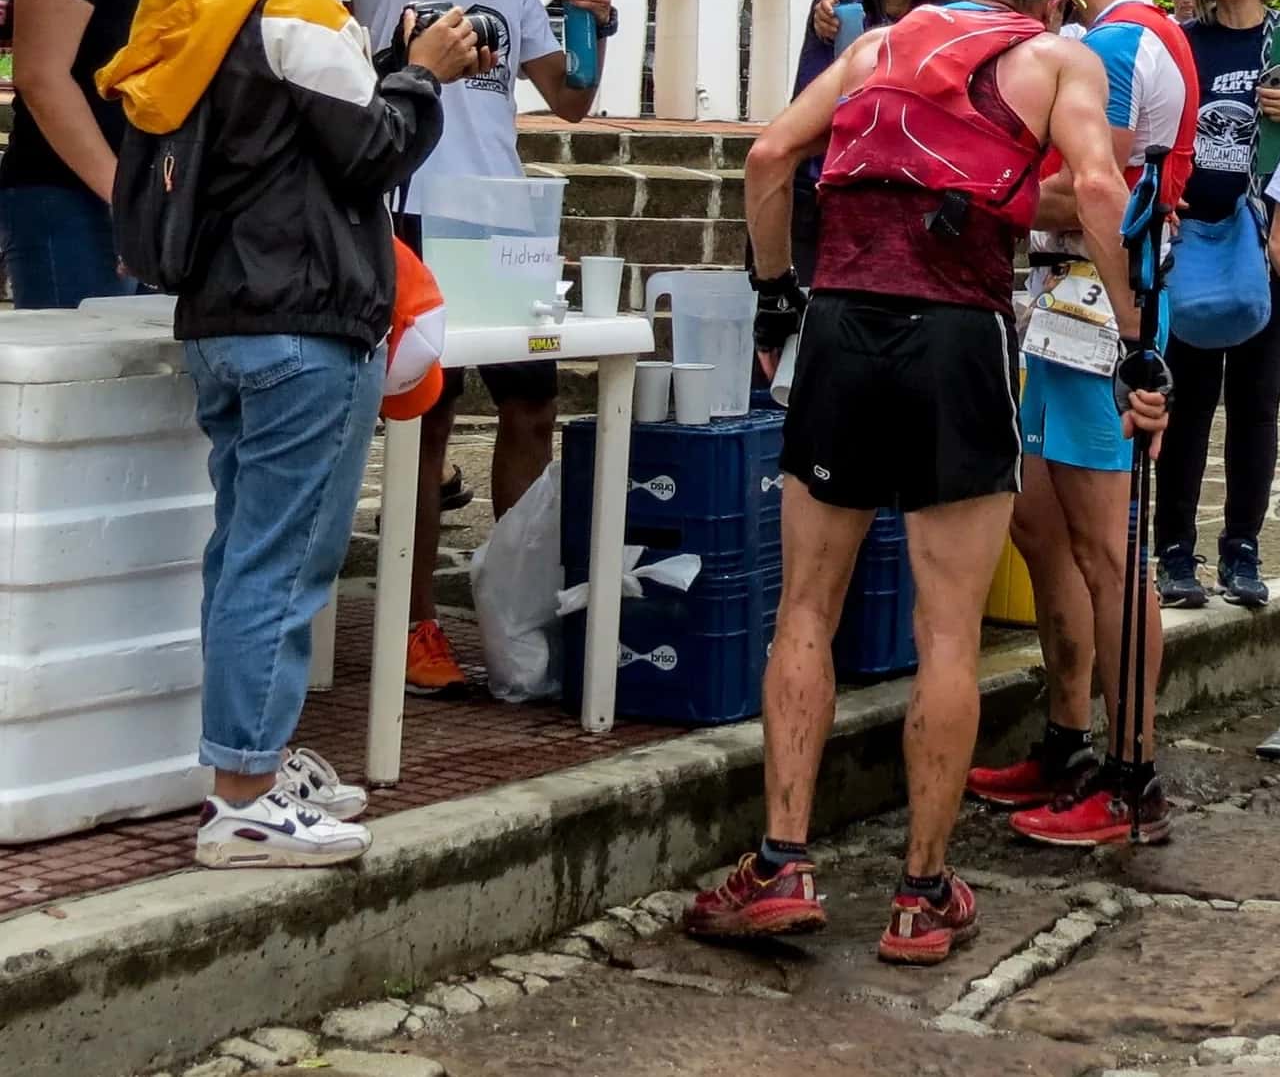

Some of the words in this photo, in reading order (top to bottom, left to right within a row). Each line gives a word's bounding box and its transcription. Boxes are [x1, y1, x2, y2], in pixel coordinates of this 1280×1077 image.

[1213, 69, 1259, 85] PEOPLE
[1211, 80, 1254, 92] PLAY'S
[1198, 137, 1250, 163] CHICAMOCH
[1081, 283, 1102, 306] 3
[650, 482, 674, 495] brisa
[651, 650, 675, 663] brisa
